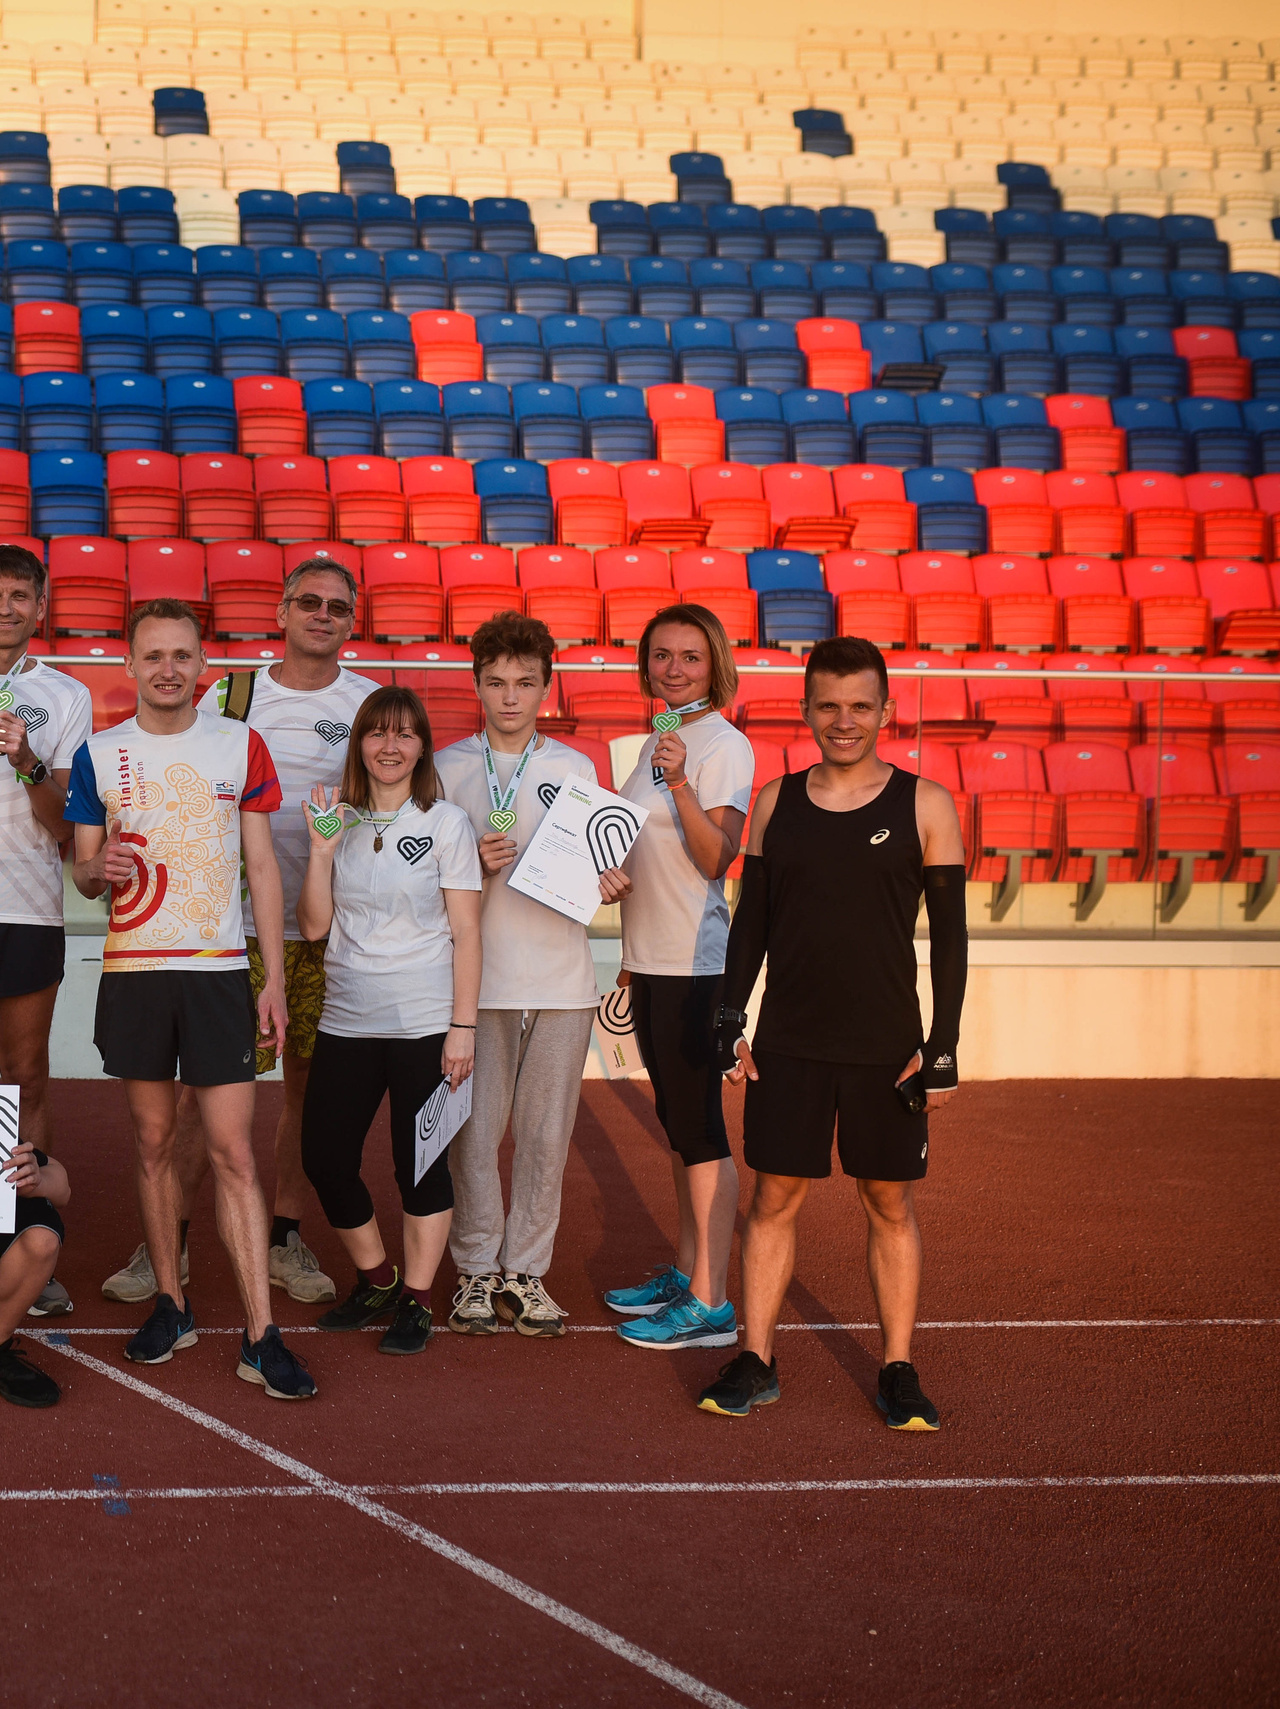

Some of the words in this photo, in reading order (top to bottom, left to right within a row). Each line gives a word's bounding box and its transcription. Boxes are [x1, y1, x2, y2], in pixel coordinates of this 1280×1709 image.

[118, 748, 132, 808] finisher
[136, 761, 147, 806] aquathlon
[568, 791, 593, 806] RUNNING
[551, 822, 577, 838] Сертификат
